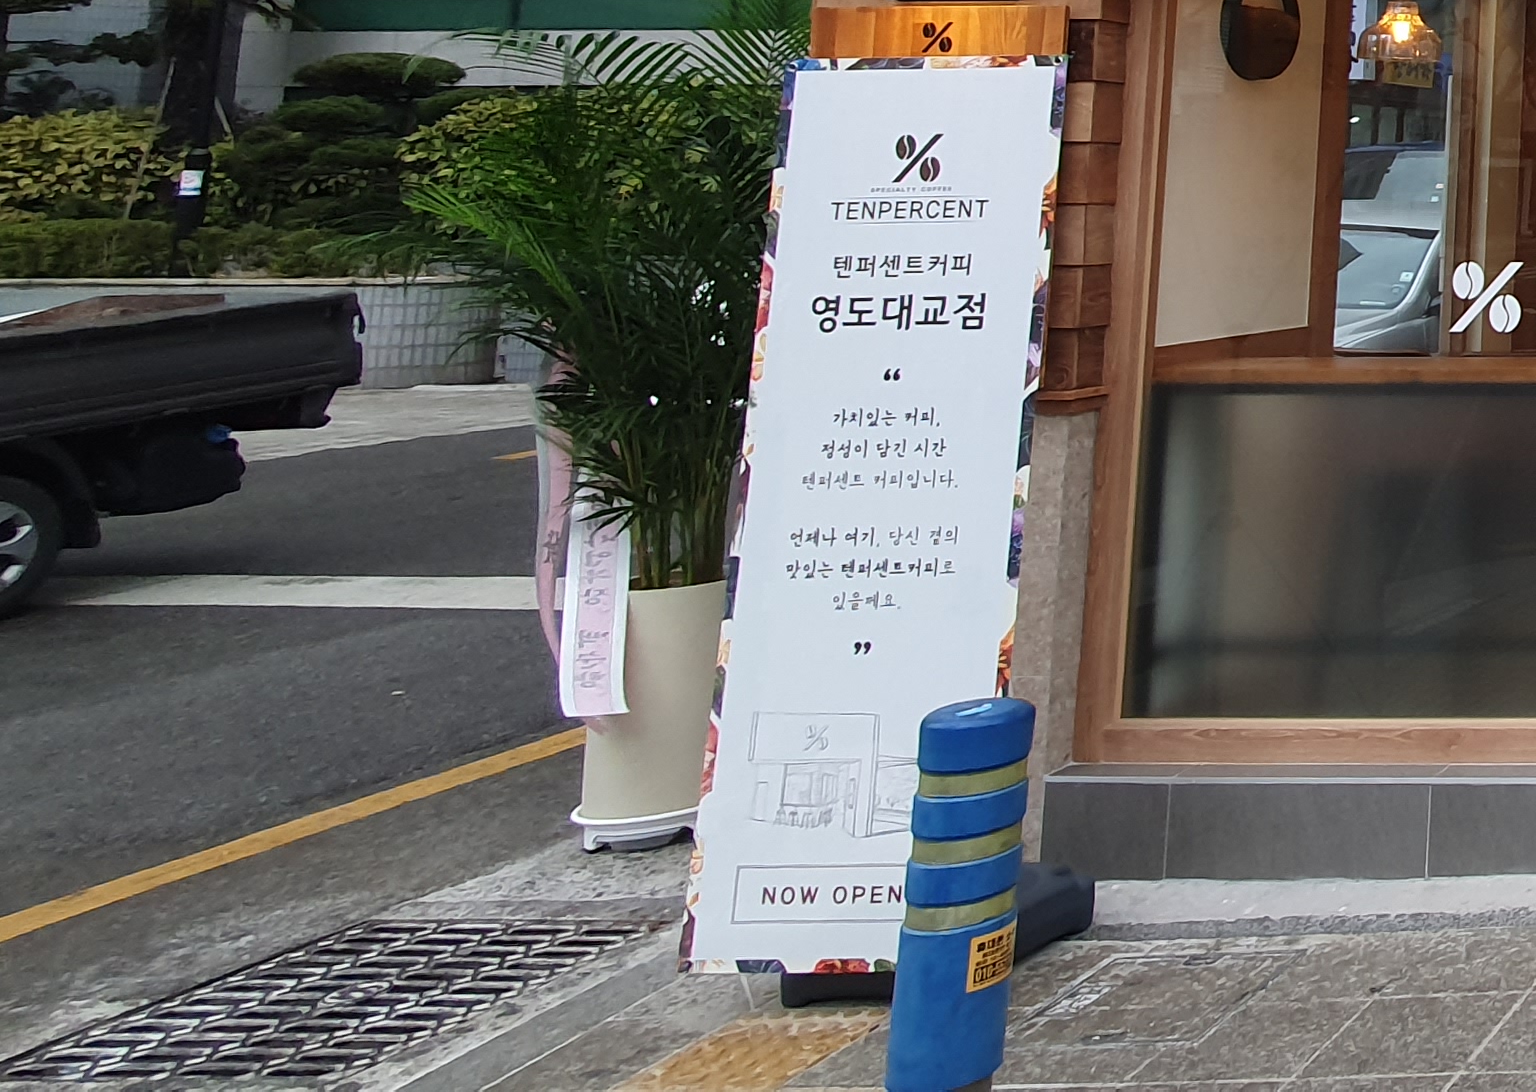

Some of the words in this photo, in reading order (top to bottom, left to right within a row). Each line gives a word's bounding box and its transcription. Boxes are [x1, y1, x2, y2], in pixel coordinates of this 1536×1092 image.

[831, 198, 990, 222] TENPERCENT
[833, 253, 972, 279] 텐퍼센트커피
[811, 292, 987, 333] 영도대교점
[833, 407, 897, 427] 가치있는
[904, 407, 940, 427] 커피,
[821, 438, 868, 459] 정성이
[876, 438, 906, 458] 담긴
[913, 438, 947, 457] 시간
[802, 470, 864, 490] 텐퍼센트
[874, 469, 958, 489] 커피입니다.
[790, 527, 838, 547] 언제나
[888, 526, 919, 546] 당신
[841, 557, 956, 579] 텐퍼센트커피로
[761, 886, 819, 905] NOW
[832, 885, 902, 904] OPEN
